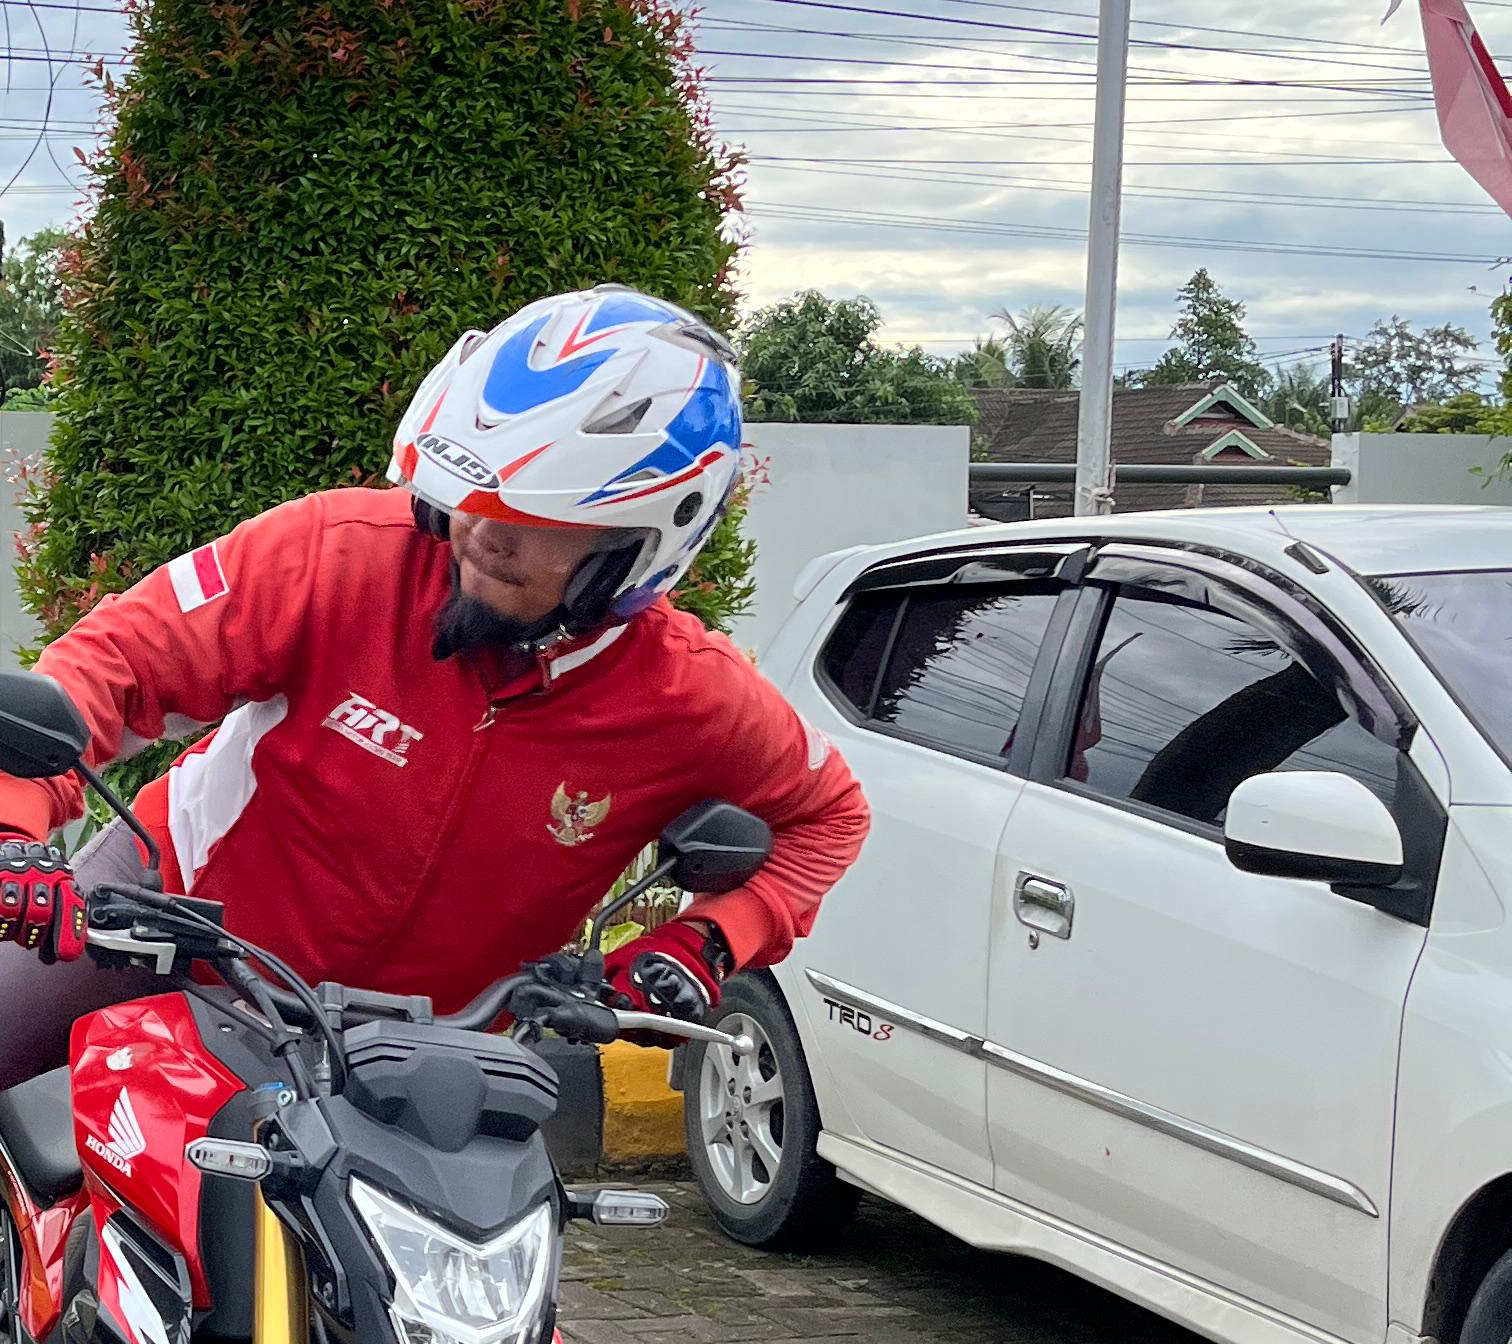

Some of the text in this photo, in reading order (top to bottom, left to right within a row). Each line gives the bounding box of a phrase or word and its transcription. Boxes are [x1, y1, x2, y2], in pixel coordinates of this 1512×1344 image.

[421, 436, 493, 480] NJS
[823, 997, 872, 1036] TRD
[84, 1133, 133, 1179] HONDA
